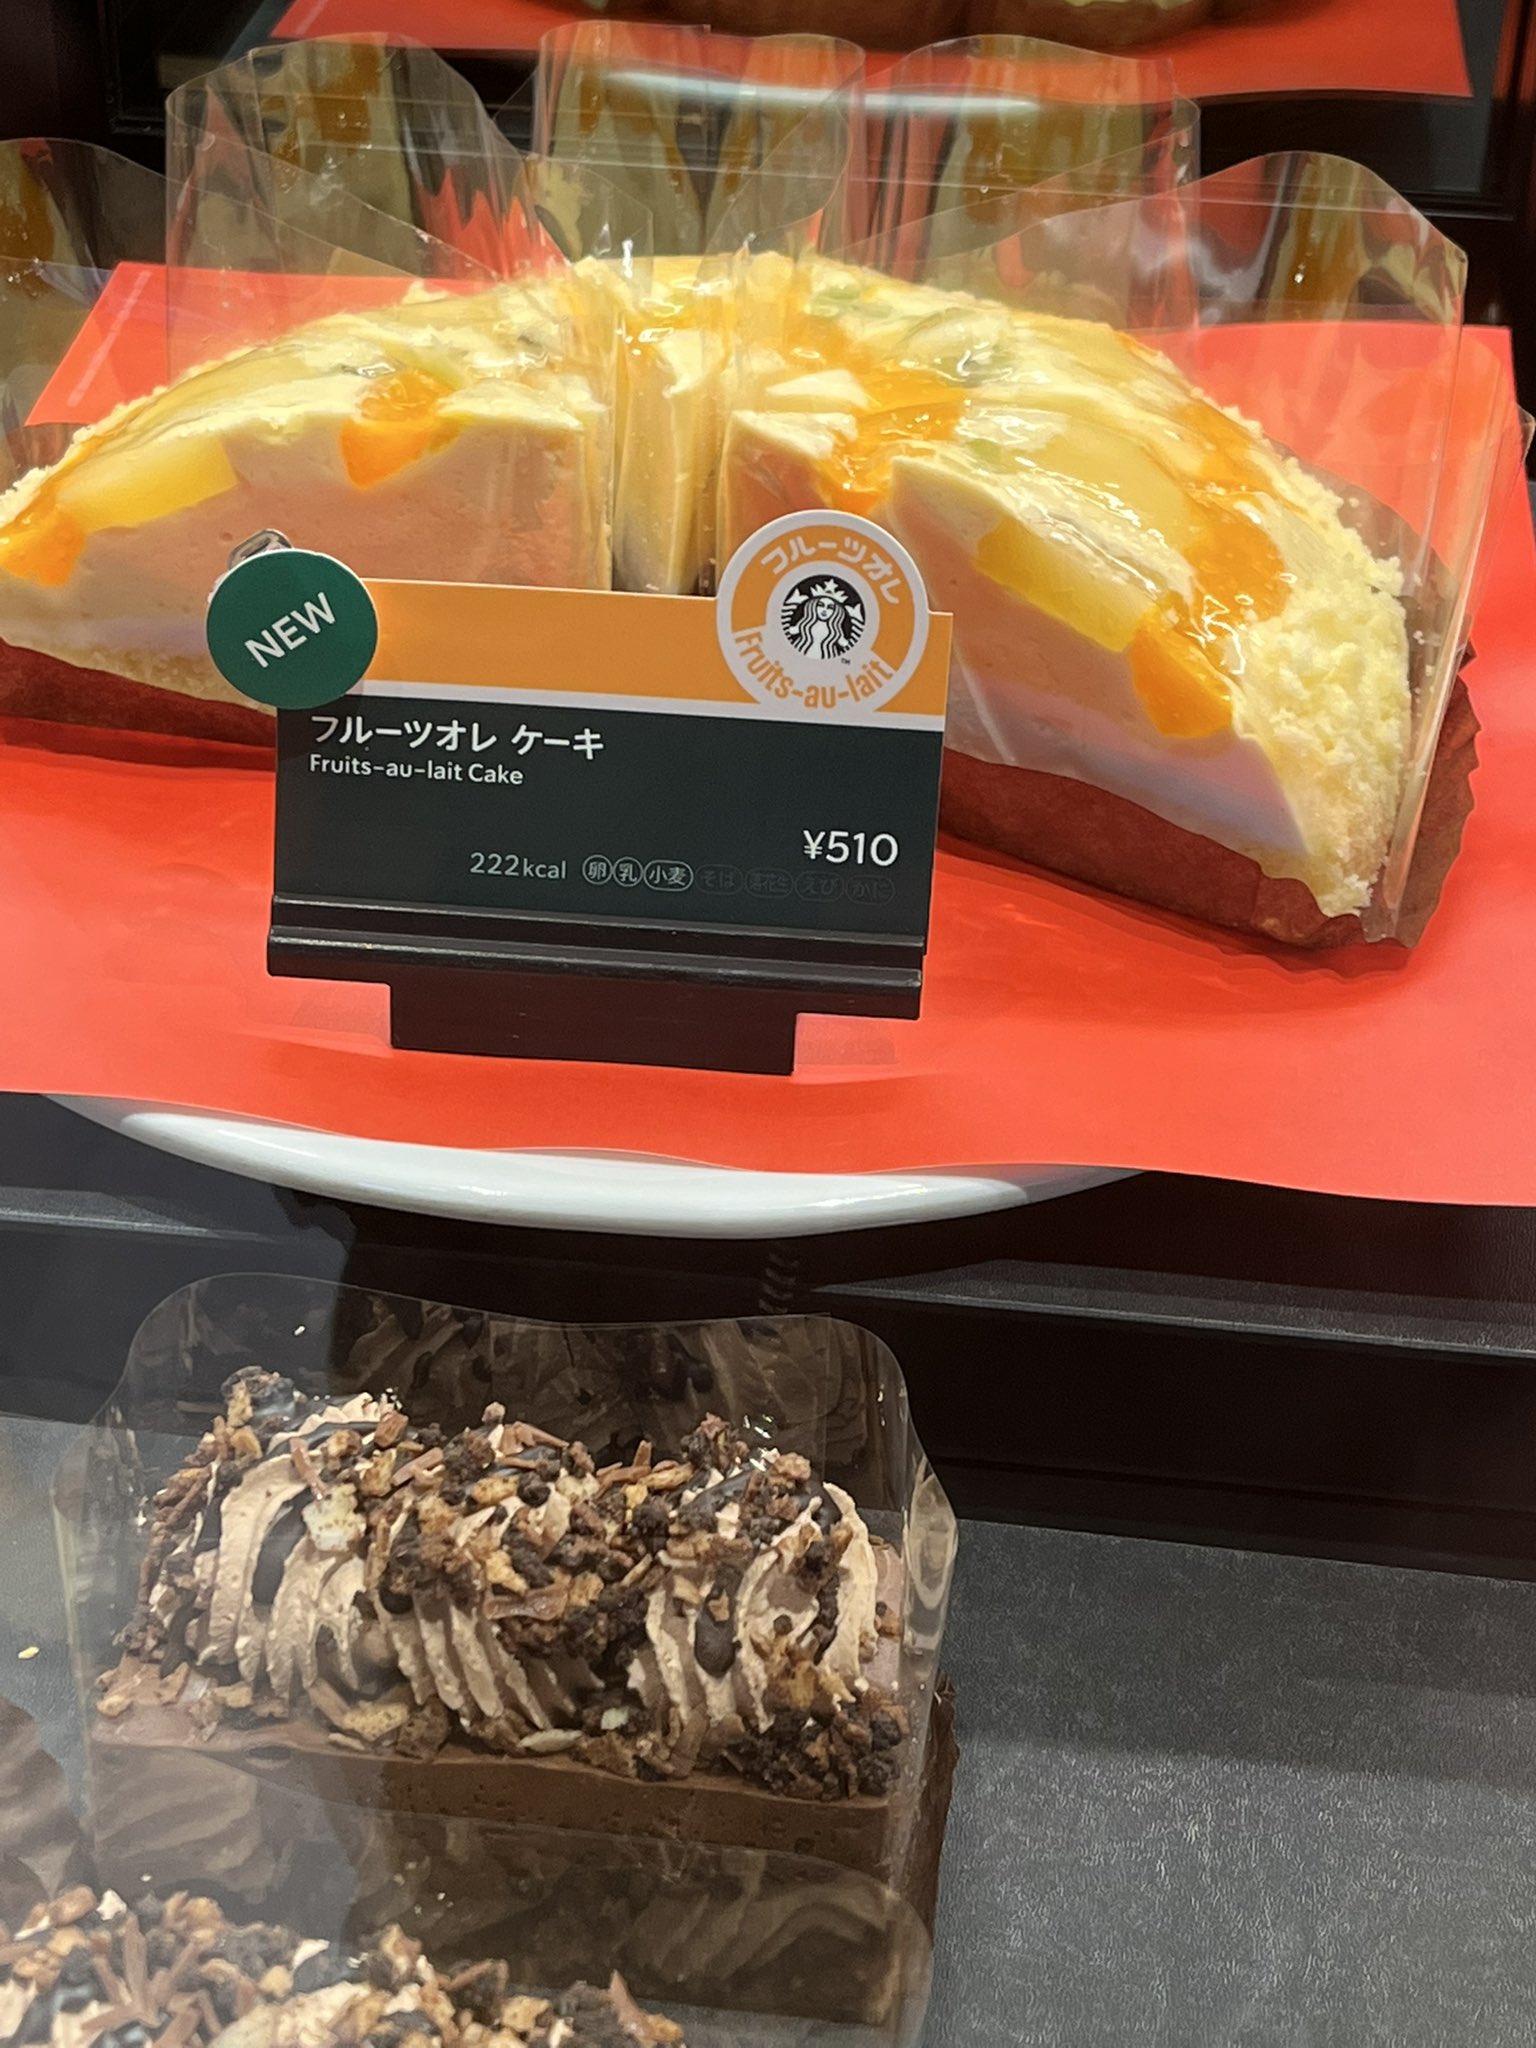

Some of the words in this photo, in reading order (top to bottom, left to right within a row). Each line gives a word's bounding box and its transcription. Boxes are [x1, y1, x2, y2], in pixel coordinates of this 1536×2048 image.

[761, 536, 900, 605] フルーツオレ
[245, 593, 337, 668] NEW
[735, 629, 894, 709] Fruits-au-lait
[310, 716, 497, 753] フルーツオレ
[511, 725, 604, 760] ケーキ
[310, 754, 463, 782] Fruits-au-lait
[468, 762, 524, 785] Cake
[469, 852, 567, 880] 222kcal
[804, 830, 898, 867] ¥510
[648, 865, 688, 886] 小麦
